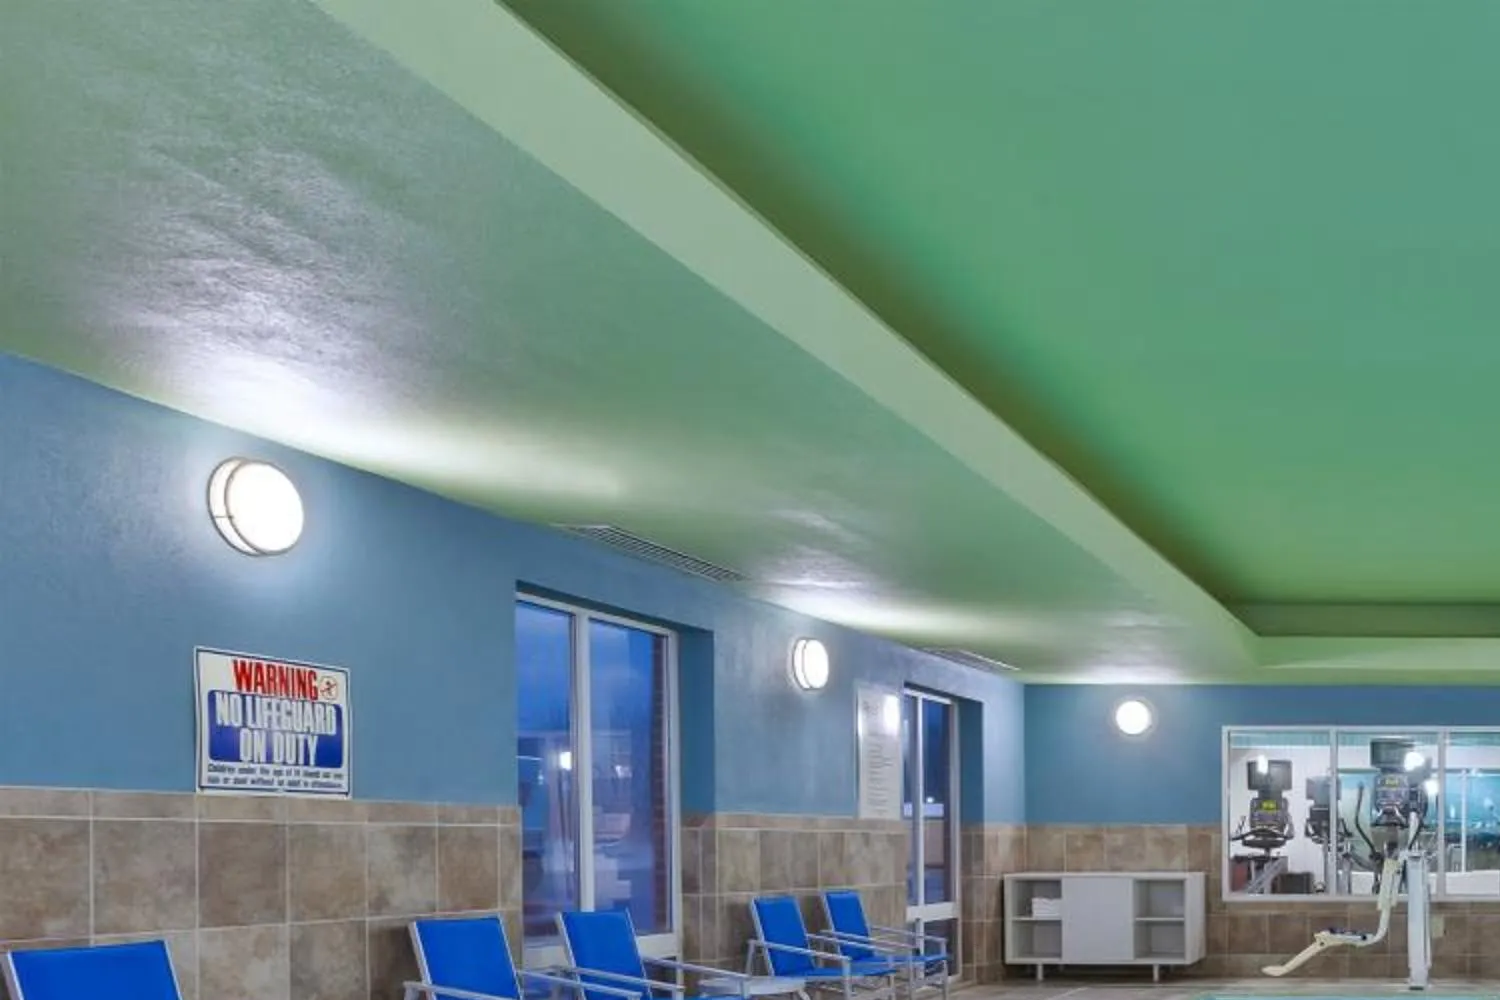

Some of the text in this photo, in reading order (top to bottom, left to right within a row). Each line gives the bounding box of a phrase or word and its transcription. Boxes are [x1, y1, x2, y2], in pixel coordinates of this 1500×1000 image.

[233, 659, 319, 701] WARNING
[215, 692, 337, 736] NO LIFEGUARD
[240, 729, 319, 767] ON DUTY
